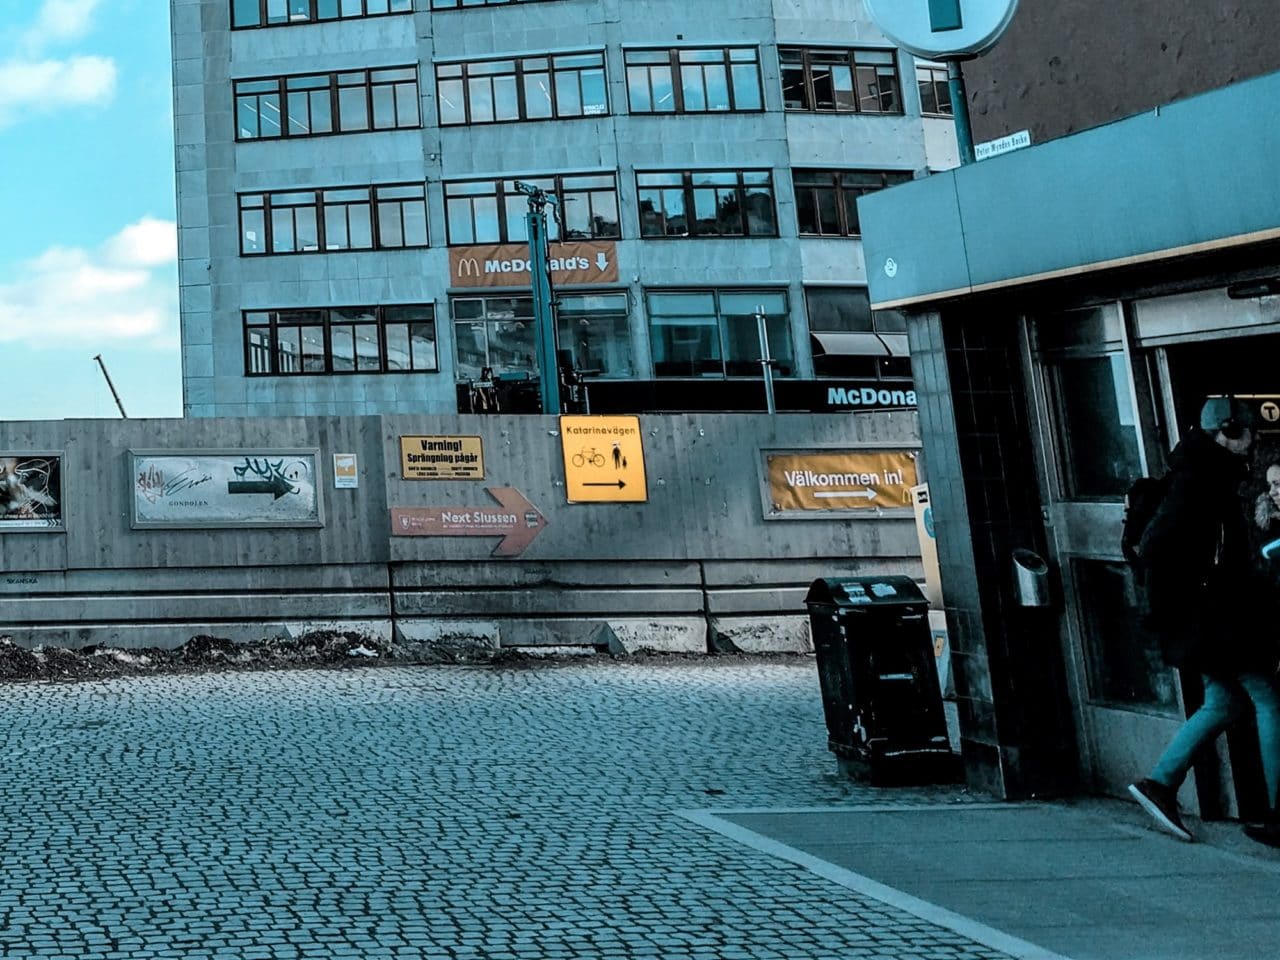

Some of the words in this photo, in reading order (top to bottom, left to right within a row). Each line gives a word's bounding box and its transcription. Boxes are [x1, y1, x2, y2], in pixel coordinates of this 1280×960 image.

[484, 256, 589, 273] McDald's
[828, 388, 917, 406] McDona
[566, 426, 636, 436] Katarinavägen
[421, 440, 462, 452] Varning!
[407, 453, 453, 464] Sprängning
[455, 453, 478, 464] pågår
[784, 470, 880, 487] Välkommen
[884, 468, 904, 485] in!
[442, 512, 472, 523] Next
[473, 511, 517, 523] Slussen
